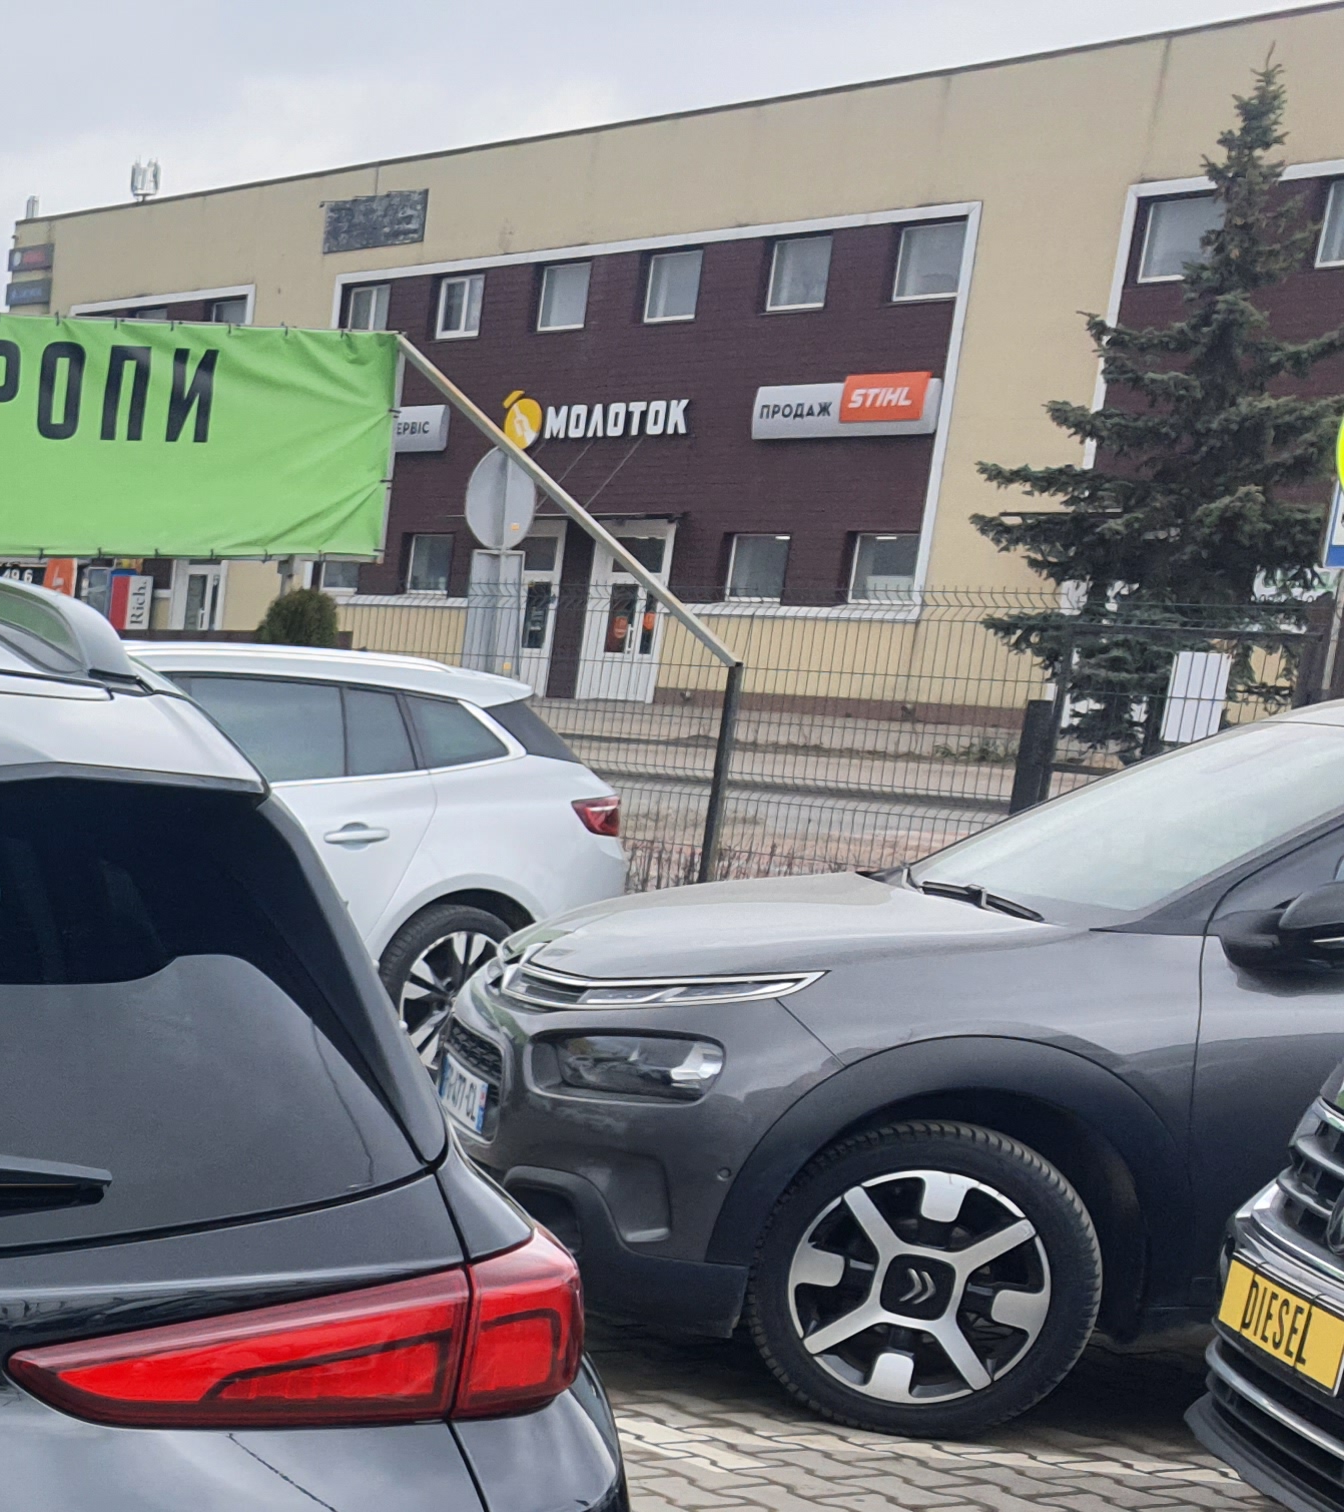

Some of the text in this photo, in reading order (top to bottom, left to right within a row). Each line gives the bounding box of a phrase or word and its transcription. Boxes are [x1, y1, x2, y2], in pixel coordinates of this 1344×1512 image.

[847, 387, 913, 409] STIHL
[544, 399, 690, 439] МОЛОТОК
[759, 401, 833, 420] ПРОДАЖ
[395, 421, 430, 435] ЕРВІС
[1241, 1278, 1312, 1366] DIESEL
